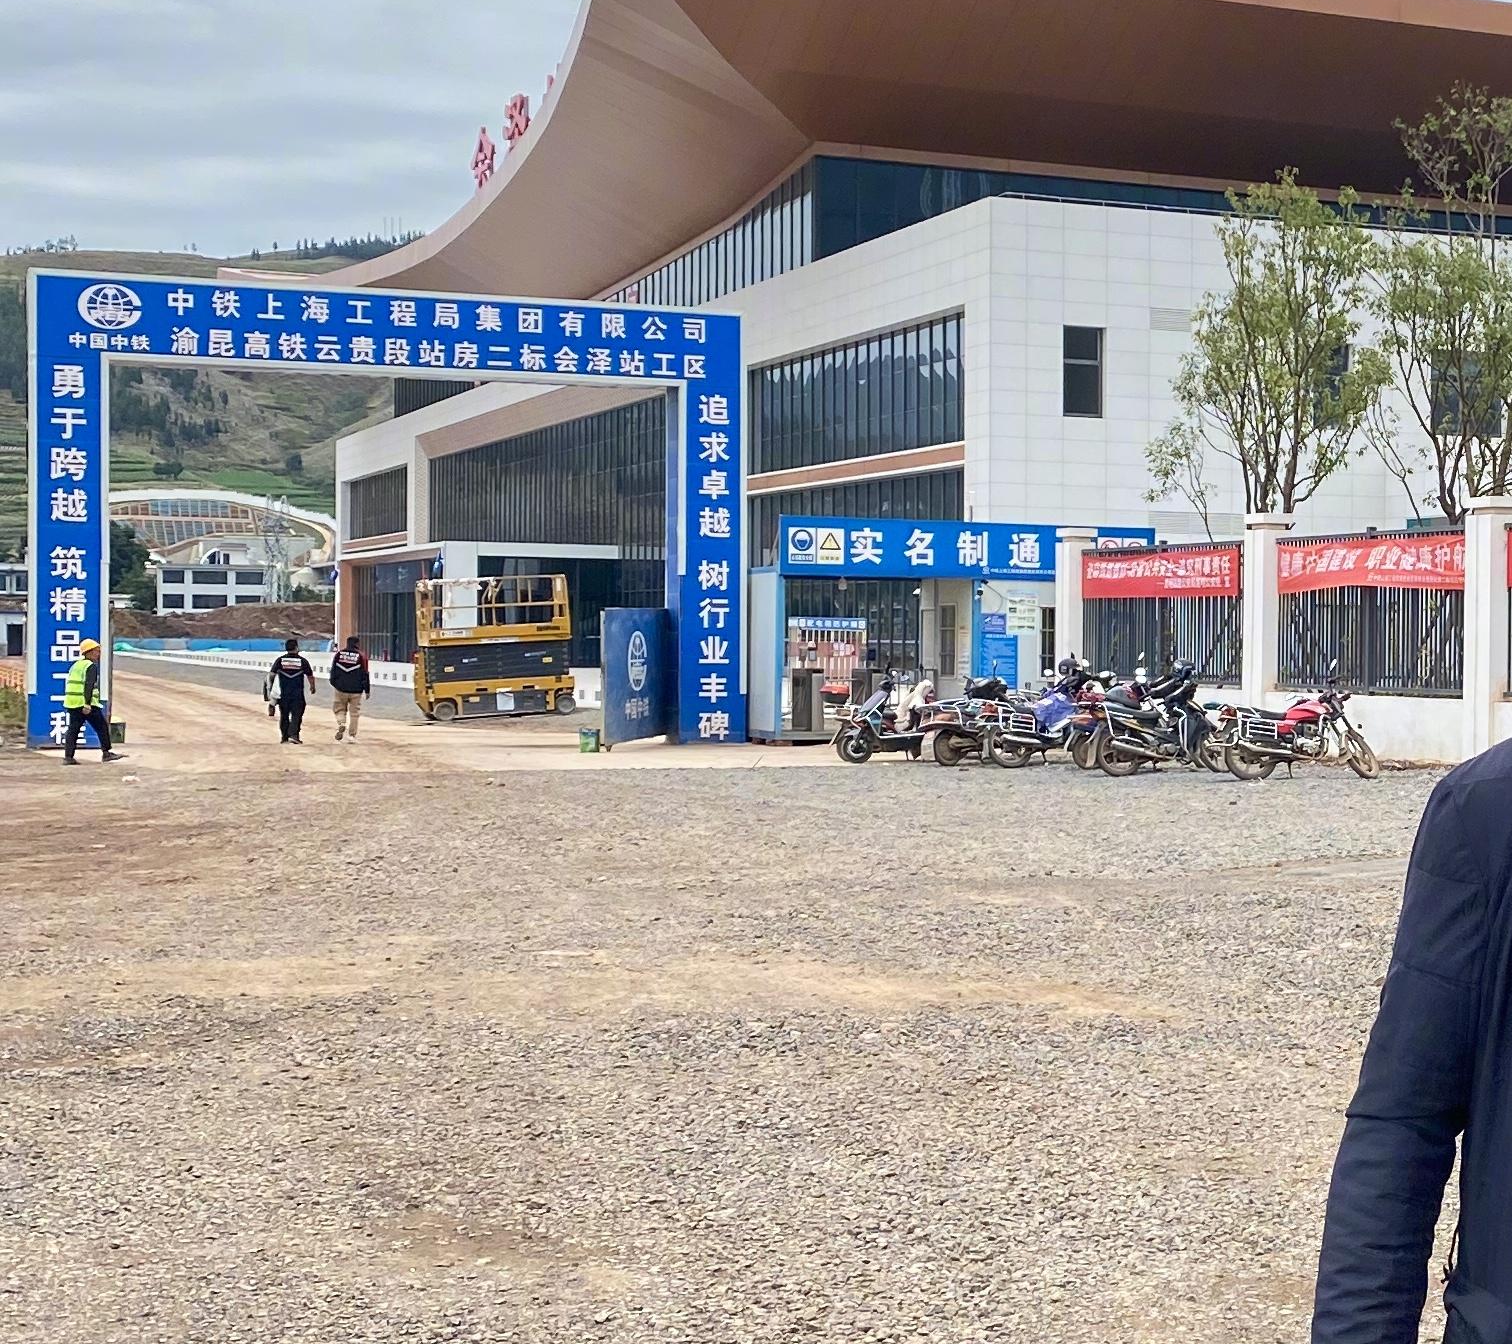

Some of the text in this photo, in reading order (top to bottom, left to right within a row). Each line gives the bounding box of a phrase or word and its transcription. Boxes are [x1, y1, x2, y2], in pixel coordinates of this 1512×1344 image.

[68, 331, 150, 351] 中国中铁
[168, 288, 707, 344] 中铁上海工程局集团有限公司
[170, 327, 706, 378] 渝昆高铁云贵段站房二标会泽站工区
[50, 364, 87, 522] 勇于跨越
[698, 394, 730, 741] 追求卓越 树行业丰碑
